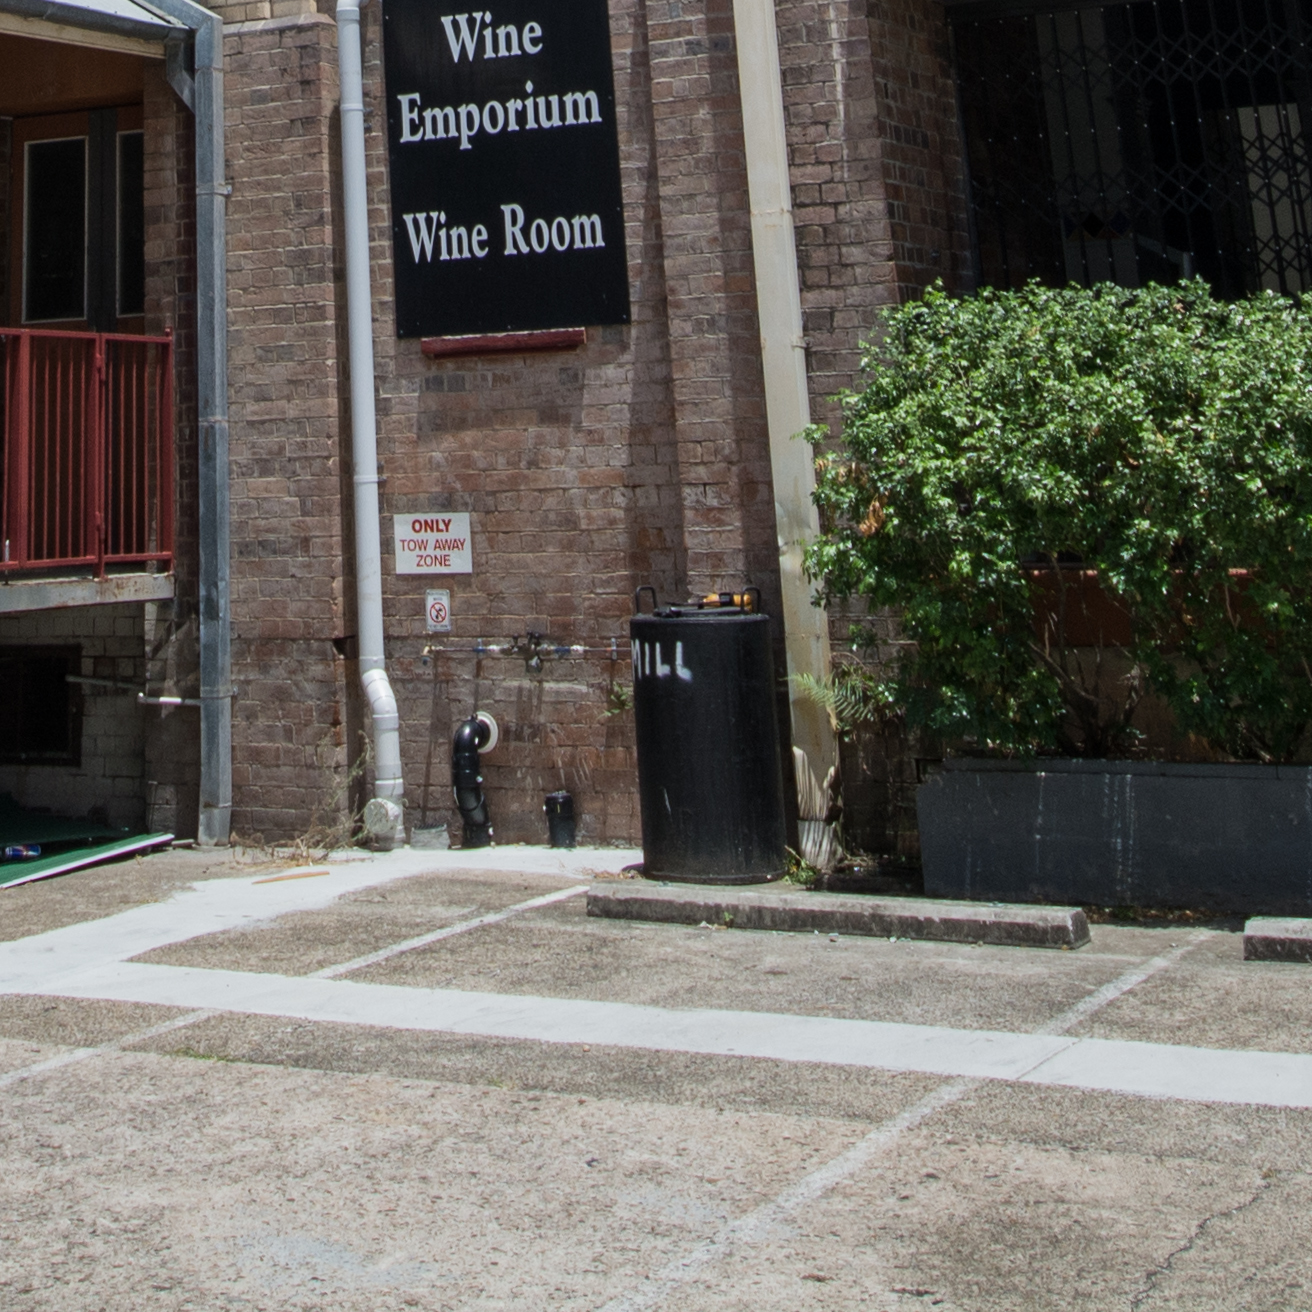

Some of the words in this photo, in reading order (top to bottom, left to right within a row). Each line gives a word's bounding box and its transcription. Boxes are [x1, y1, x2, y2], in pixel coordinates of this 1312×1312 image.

[440, 10, 544, 64] Wine
[396, 80, 603, 151] Emporium
[402, 209, 489, 264] Wine
[500, 203, 606, 257] Room
[411, 518, 452, 533] ONLY
[399, 538, 429, 552] TOW
[433, 537, 466, 552] AWAY
[415, 554, 452, 568] ZONE
